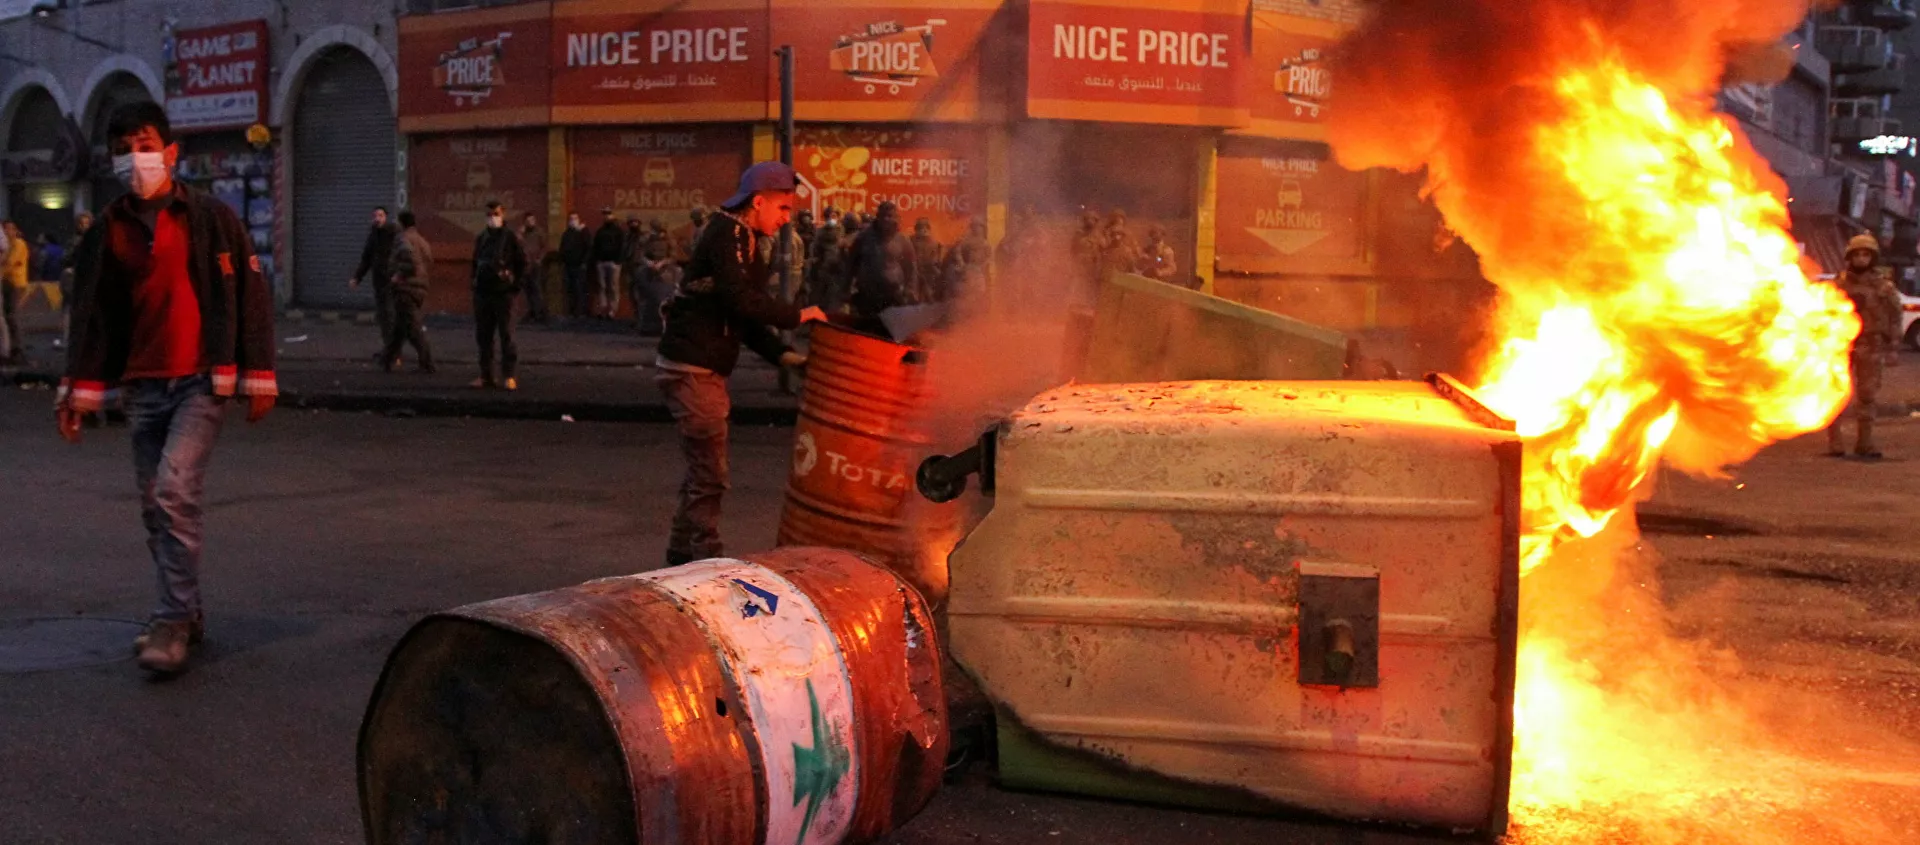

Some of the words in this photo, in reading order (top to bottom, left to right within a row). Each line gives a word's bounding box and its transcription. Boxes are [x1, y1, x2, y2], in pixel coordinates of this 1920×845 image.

[870, 20, 898, 35] NICE
[177, 35, 231, 59] GAME
[567, 31, 640, 67] NICE
[650, 27, 749, 64] PRICE
[852, 41, 921, 72] PRICE
[1054, 24, 1128, 62] NICE
[1138, 29, 1229, 68] PRICE
[186, 60, 257, 88] PLANET
[447, 55, 494, 85] PRICE
[1288, 66, 1332, 97] PRIC
[871, 158, 912, 176] NICE
[917, 158, 970, 177] PRICE
[614, 188, 706, 208] PARKING
[1256, 208, 1321, 229] PARKING
